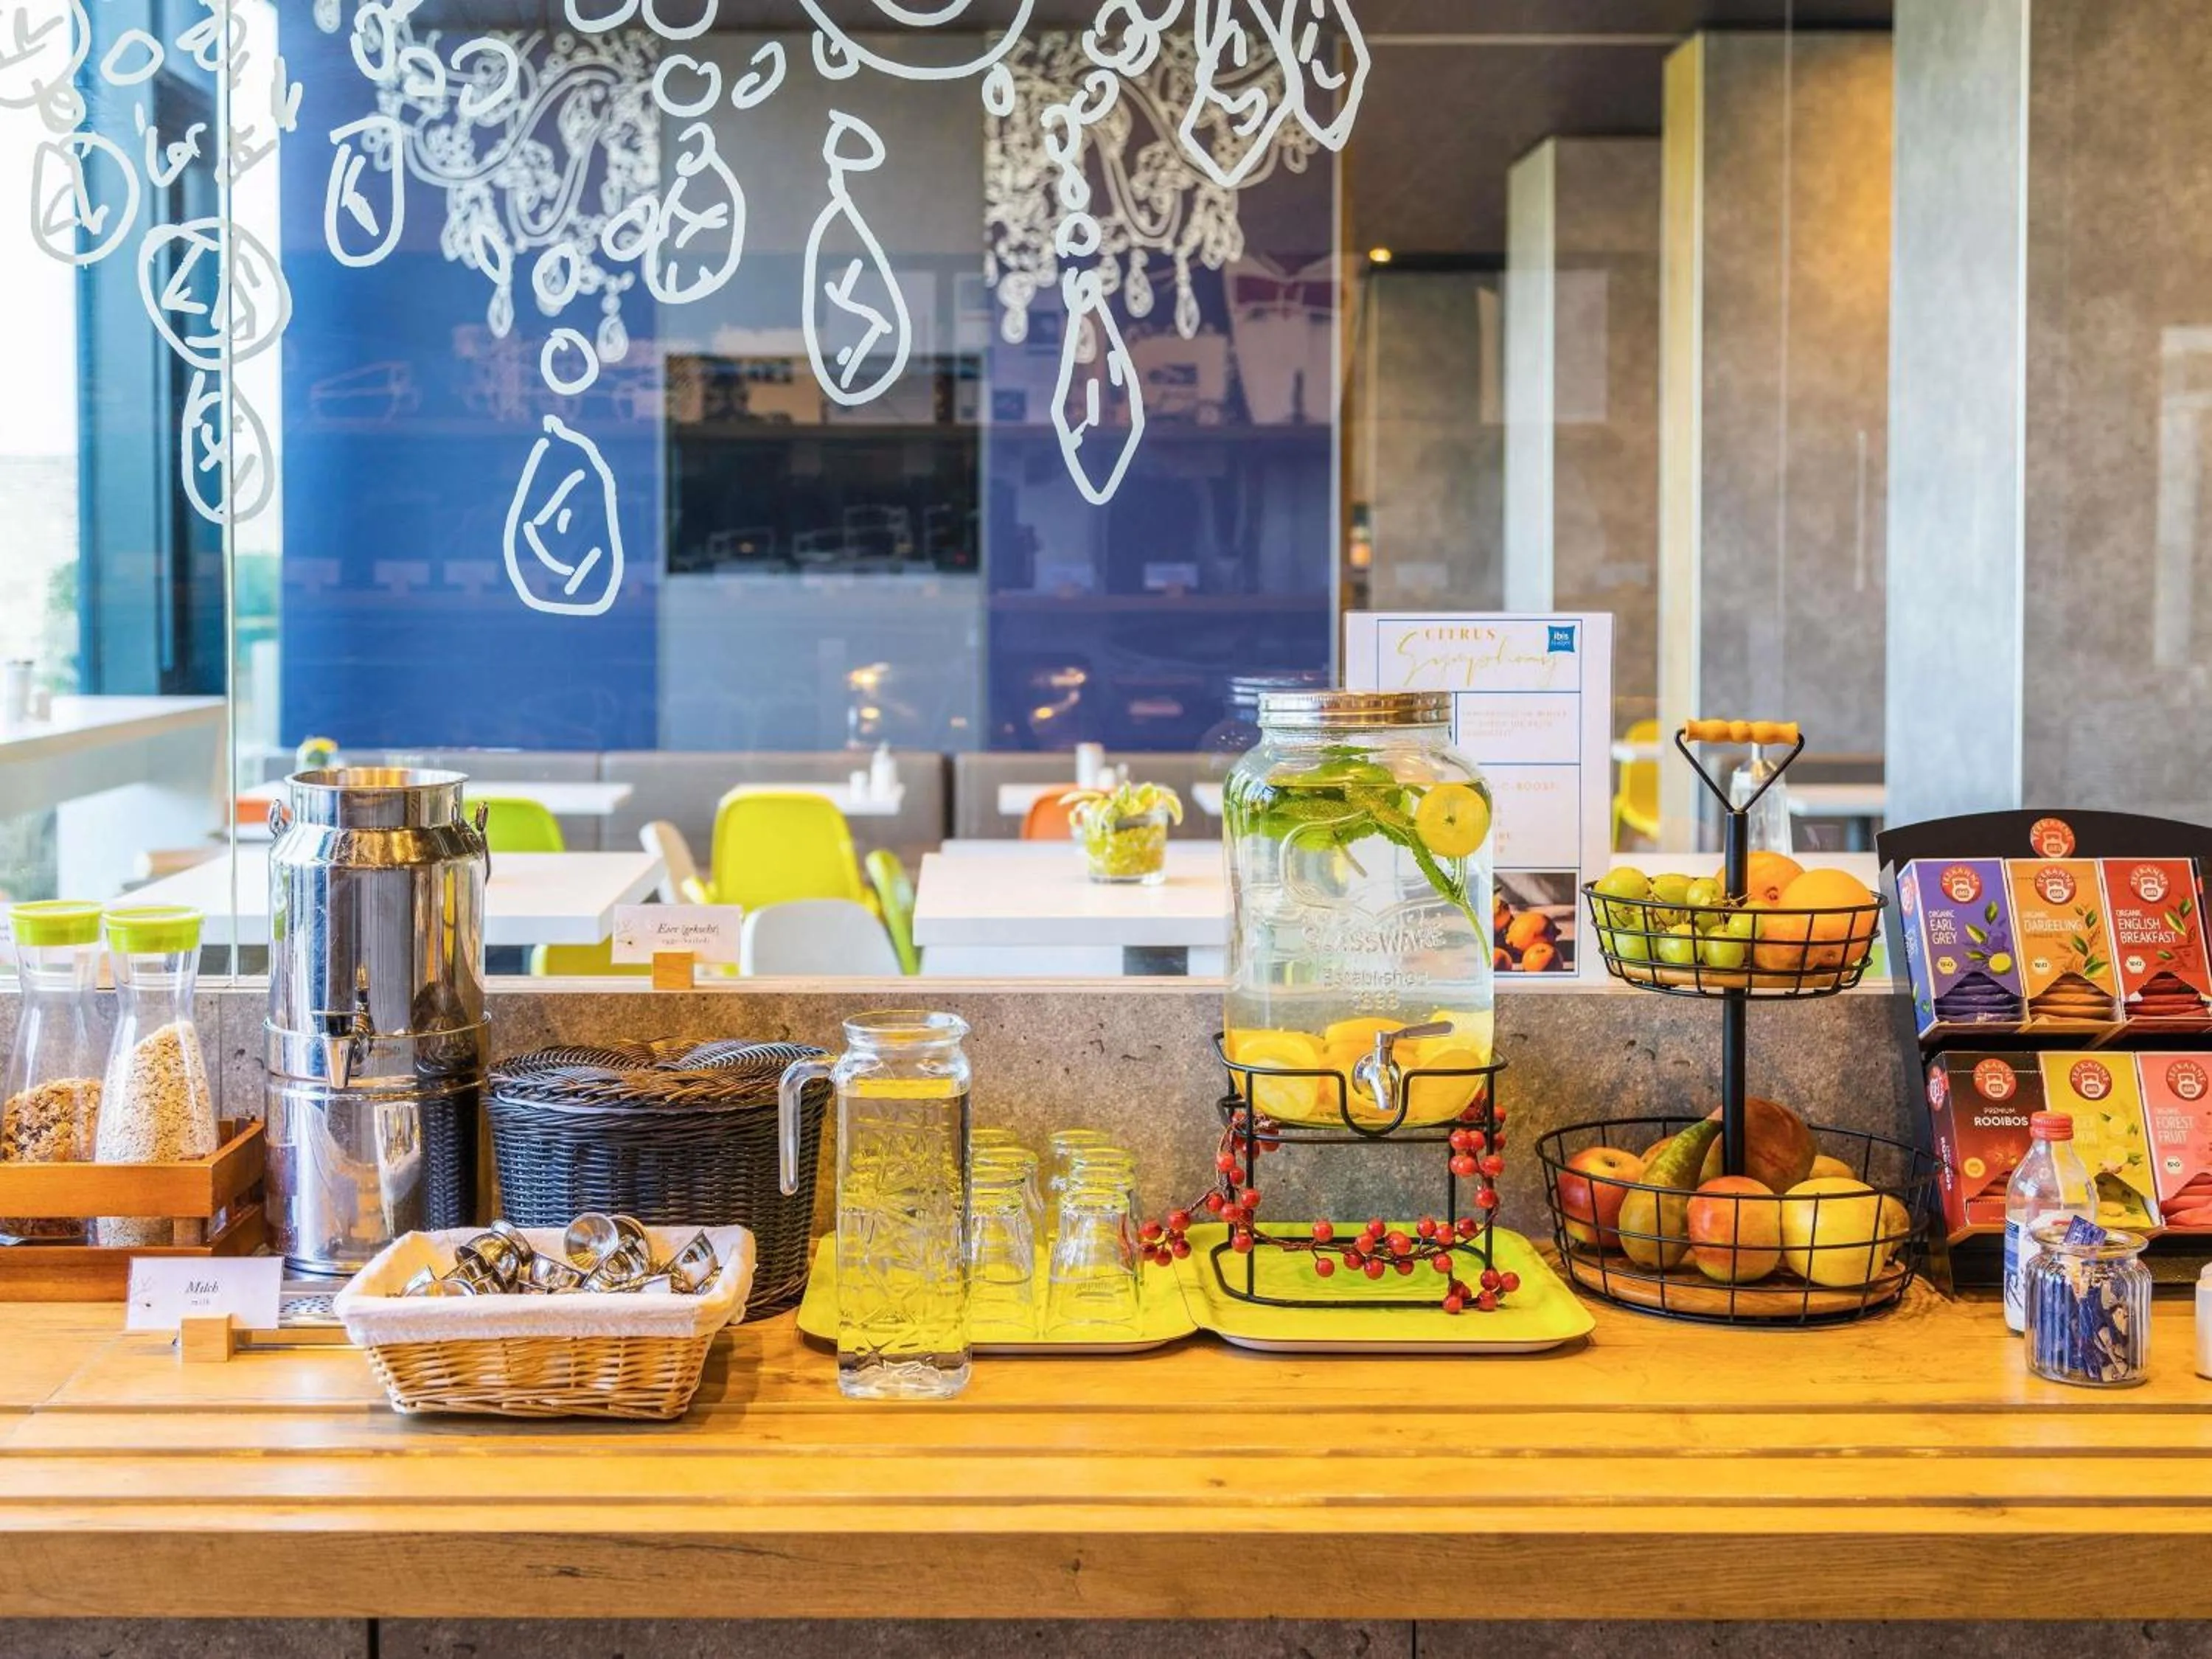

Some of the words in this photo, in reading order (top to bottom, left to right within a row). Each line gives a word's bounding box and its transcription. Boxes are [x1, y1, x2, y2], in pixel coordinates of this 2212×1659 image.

[1425, 627, 1496, 640] CITRUS
[1554, 630, 1569, 640] ibis
[1928, 909, 1955, 918] ORGANIC
[2115, 909, 2143, 917] ORGANIC
[1930, 919, 1956, 931] EARL
[2023, 919, 2084, 932] DARJEELING
[2117, 918, 2161, 930] ENGLISH
[1932, 932, 1958, 945] GREY
[2120, 931, 2177, 944] BREAKFAST
[1974, 1116, 2028, 1127] ROOIBOS
[2155, 1116, 2194, 1129] FOREST
[2157, 1130, 2188, 1144] FRUIT
[185, 1281, 220, 1294] Milch
